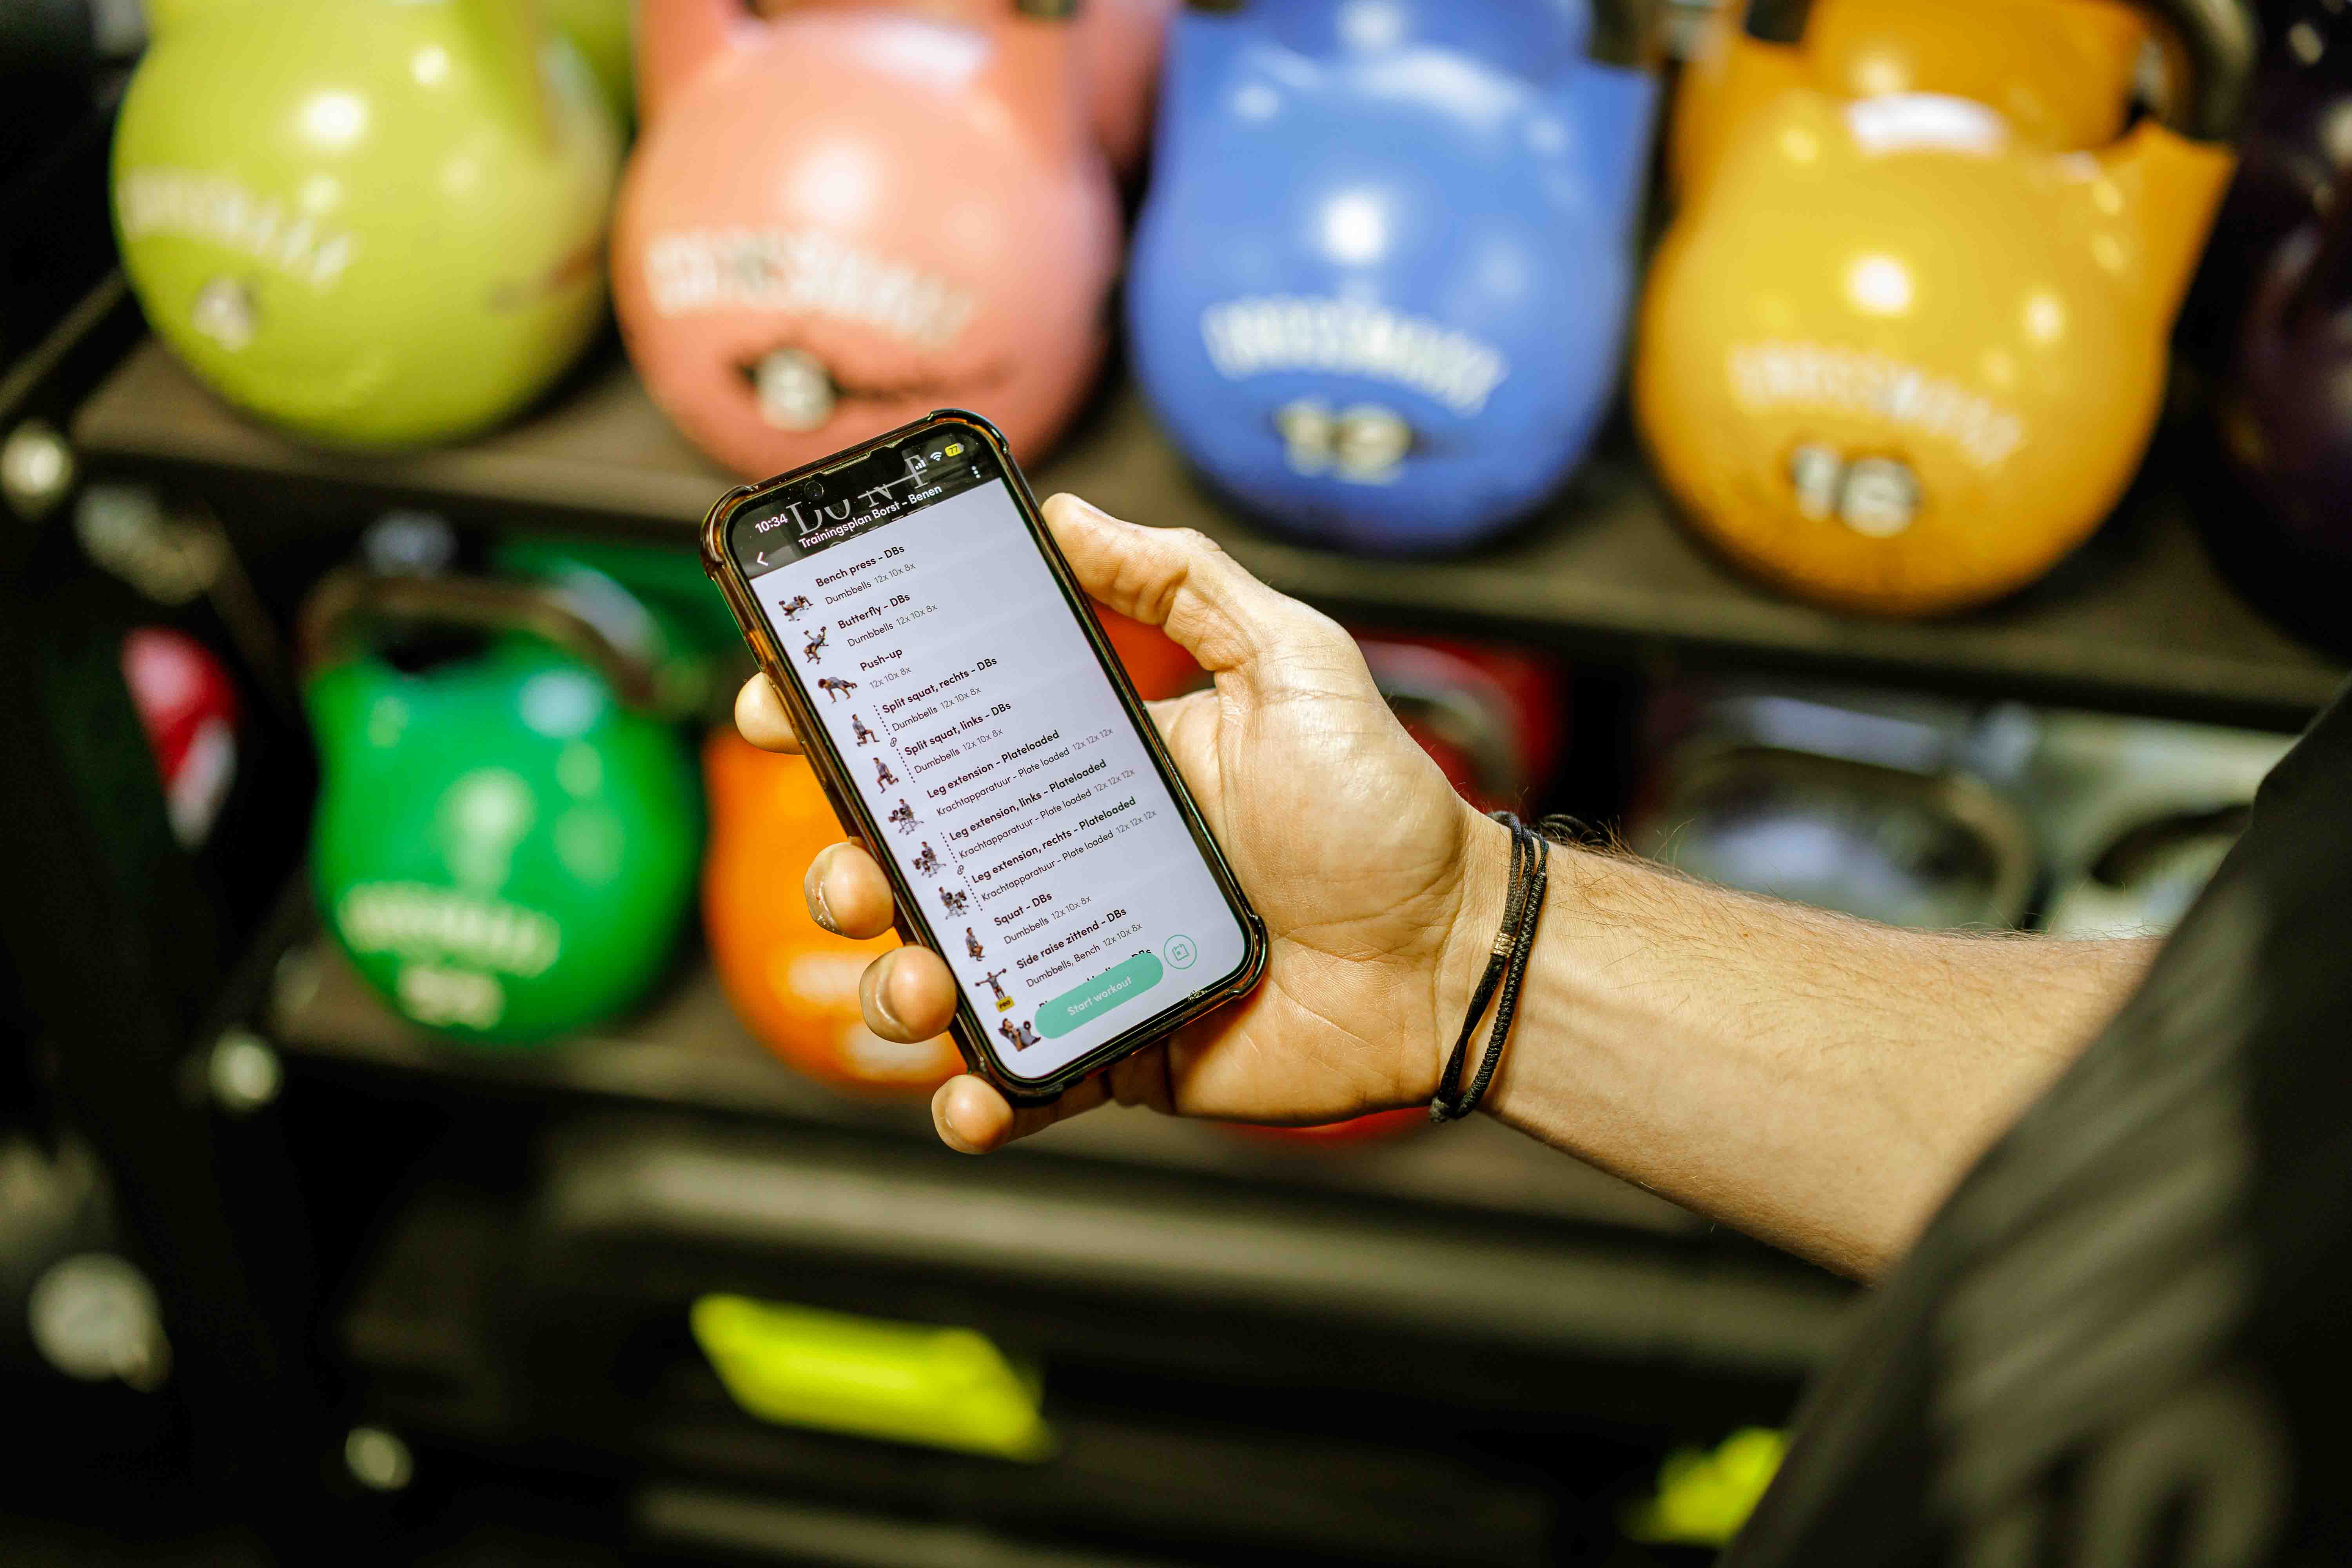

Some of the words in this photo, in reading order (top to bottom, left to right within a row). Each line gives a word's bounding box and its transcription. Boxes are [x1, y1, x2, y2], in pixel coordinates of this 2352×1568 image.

[949, 445, 958, 454] 77
[1275, 397, 1412, 486] 12
[1792, 442, 1920, 537] 16
[755, 514, 788, 533] 10:34
[798, 515, 872, 548] Trainingsplan
[871, 501, 900, 519] Borst
[908, 486, 942, 504] Benen
[815, 569, 848, 587] Bench
[849, 558, 876, 576] press
[884, 546, 904, 559] DBs
[825, 581, 871, 604] Dumbbells
[874, 575, 889, 584] 12x
[888, 568, 904, 577] 10x
[837, 606, 881, 629] Butterfly
[889, 595, 910, 607] DBs
[847, 623, 894, 646] Dumbbells
[896, 616, 911, 625] 12x
[910, 610, 926, 619] 10x
[860, 649, 902, 671] Push-up
[869, 679, 884, 689] 12x
[884, 673, 900, 682] 10x
[882, 698, 906, 713] Split
[907, 684, 938, 702] squat,
[939, 671, 969, 688] rechts
[976, 659, 997, 671] DBs
[892, 706, 938, 731] Dumbbells
[940, 700, 955, 709] 12x
[954, 693, 969, 702] 10x
[904, 740, 928, 755] Split
[929, 726, 960, 744] squat,
[959, 716, 983, 730] links
[991, 703, 1011, 716] DBs
[914, 748, 960, 773] Dumbbells
[962, 741, 977, 751] 12x
[976, 734, 991, 744] 10x
[992, 729, 1004, 737] 8x
[927, 786, 947, 798] Leg
[948, 763, 994, 789] extension
[1001, 730, 1060, 763] Plateloaded
[936, 777, 1010, 816] Krachtapparatuur
[1018, 764, 1040, 777] Plate
[1040, 747, 1070, 766] loaded
[1072, 741, 1086, 751] 12x
[1086, 735, 1100, 744] 12x
[1099, 729, 1113, 738] 12x
[949, 828, 969, 841] Leg
[970, 805, 1019, 831] extension,
[1018, 793, 1042, 807] links
[1049, 759, 1107, 792] Plateloaded
[959, 818, 1033, 858] Krachtapparatuur
[1040, 806, 1062, 819] Plate
[1062, 788, 1092, 808] loaded
[1094, 782, 1108, 792] 12x
[1108, 776, 1122, 785] 12x
[1121, 769, 1135, 779] 12x
[971, 871, 991, 883] Leg
[993, 848, 1041, 873] extension,
[1042, 831, 1072, 849] rechts
[1078, 796, 1136, 830] Plateloaded
[981, 861, 1055, 901] Krachtapparatuur
[1062, 847, 1084, 861] Plate
[1084, 829, 1114, 850] loaded
[1116, 824, 1130, 834] 12x
[1129, 817, 1143, 827] 12x
[1143, 811, 1157, 820] 12x
[994, 906, 1024, 926] Squat
[1031, 894, 1052, 907] DBs
[1004, 918, 1049, 944] Dumbbells
[1051, 909, 1066, 919] 12x
[1065, 902, 1080, 912] 10x
[1080, 897, 1092, 905] 8x
[1016, 955, 1038, 969] Side
[1040, 941, 1064, 957] raise
[1066, 920, 1100, 944] zittend
[1106, 909, 1126, 922] DBs
[1026, 960, 1074, 987] Dumbbells,
[1073, 944, 1100, 962] Bench
[1103, 937, 1117, 947] 12x
[1116, 929, 1132, 940] 10x
[1132, 924, 1143, 932] 8x
[1067, 997, 1093, 1016] Start
[1093, 976, 1131, 1002] workout
